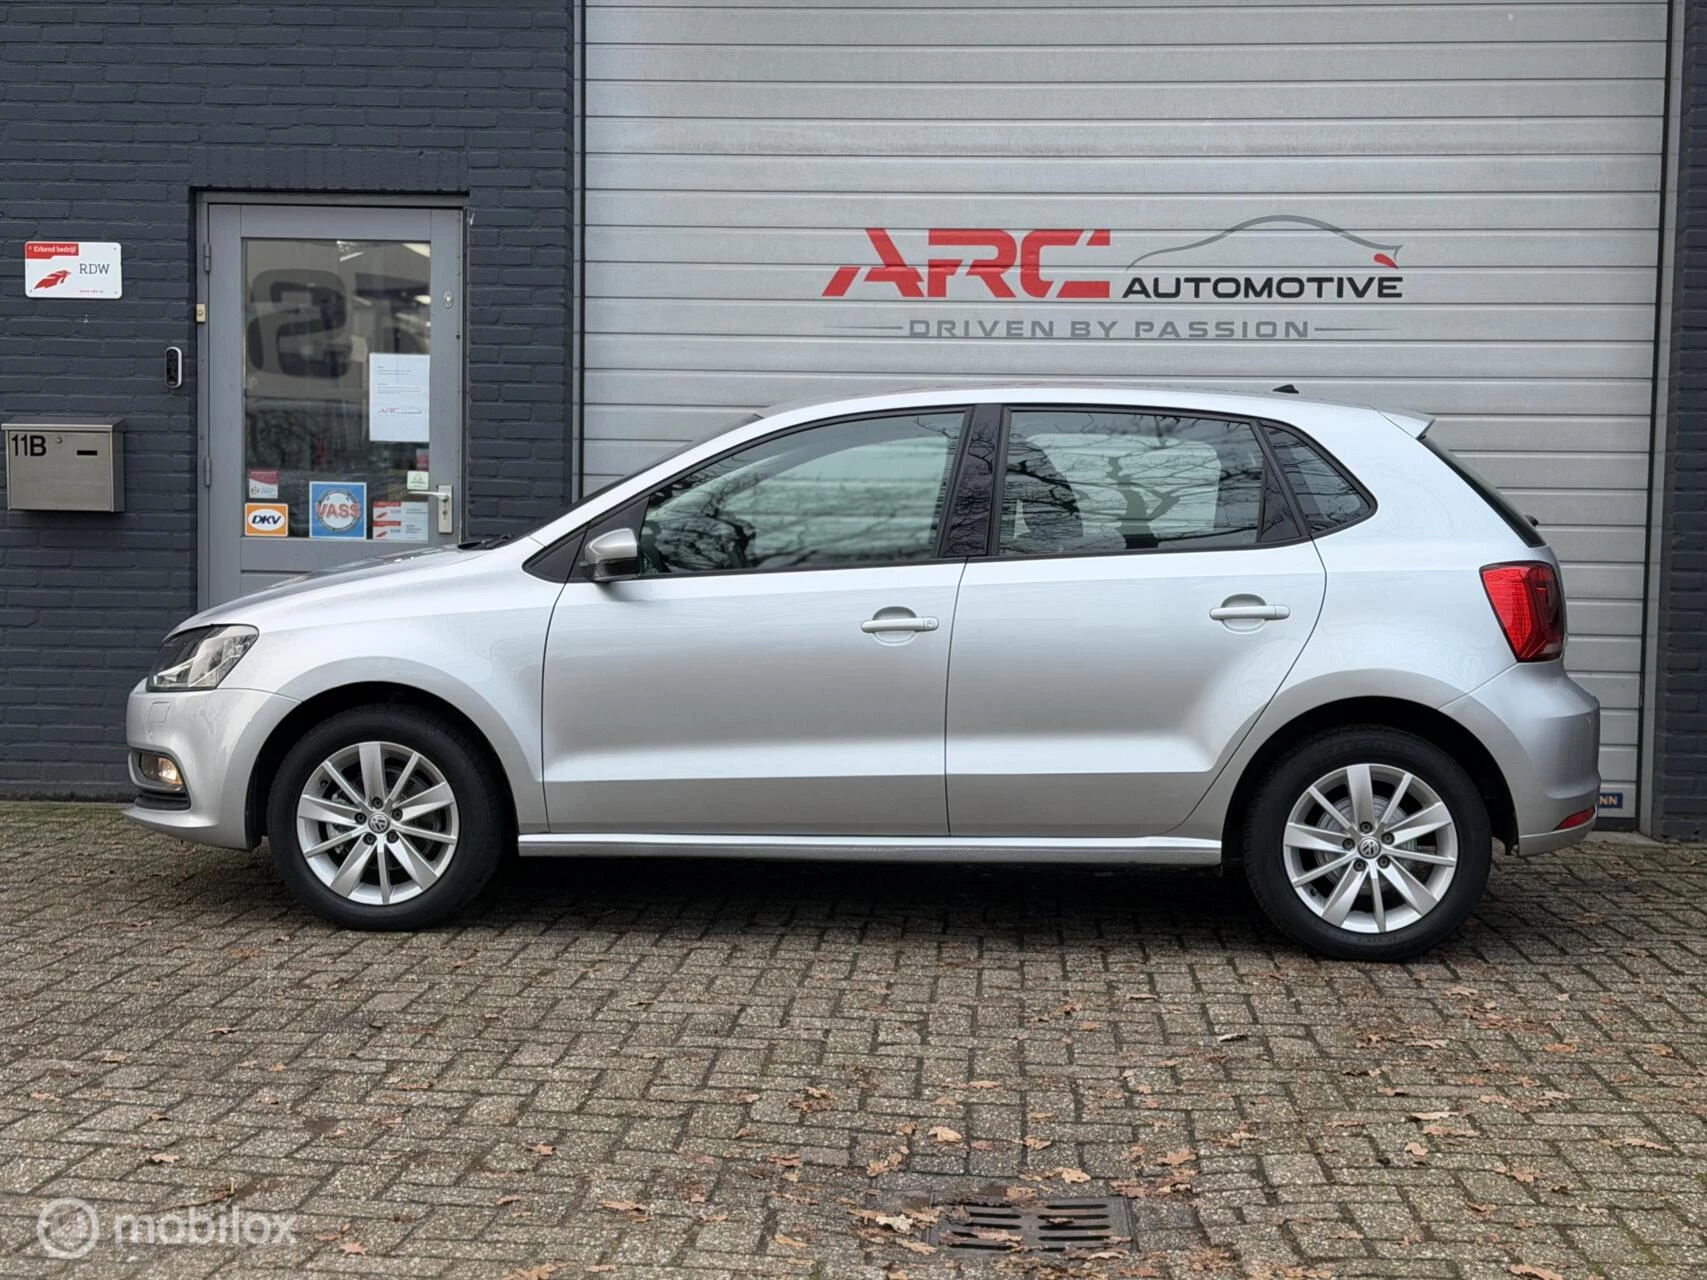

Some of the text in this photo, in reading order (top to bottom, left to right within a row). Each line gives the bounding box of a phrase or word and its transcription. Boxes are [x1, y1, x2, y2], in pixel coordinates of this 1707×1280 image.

[79, 263, 110, 275] RDW
[821, 228, 1111, 298] ARC
[1122, 276, 1404, 299] AUTOMOTIVE
[909, 319, 1309, 338] DRIVEN BY PASSION
[11, 434, 47, 456] 11B
[251, 514, 282, 525] DKV
[315, 503, 361, 519] VASS
